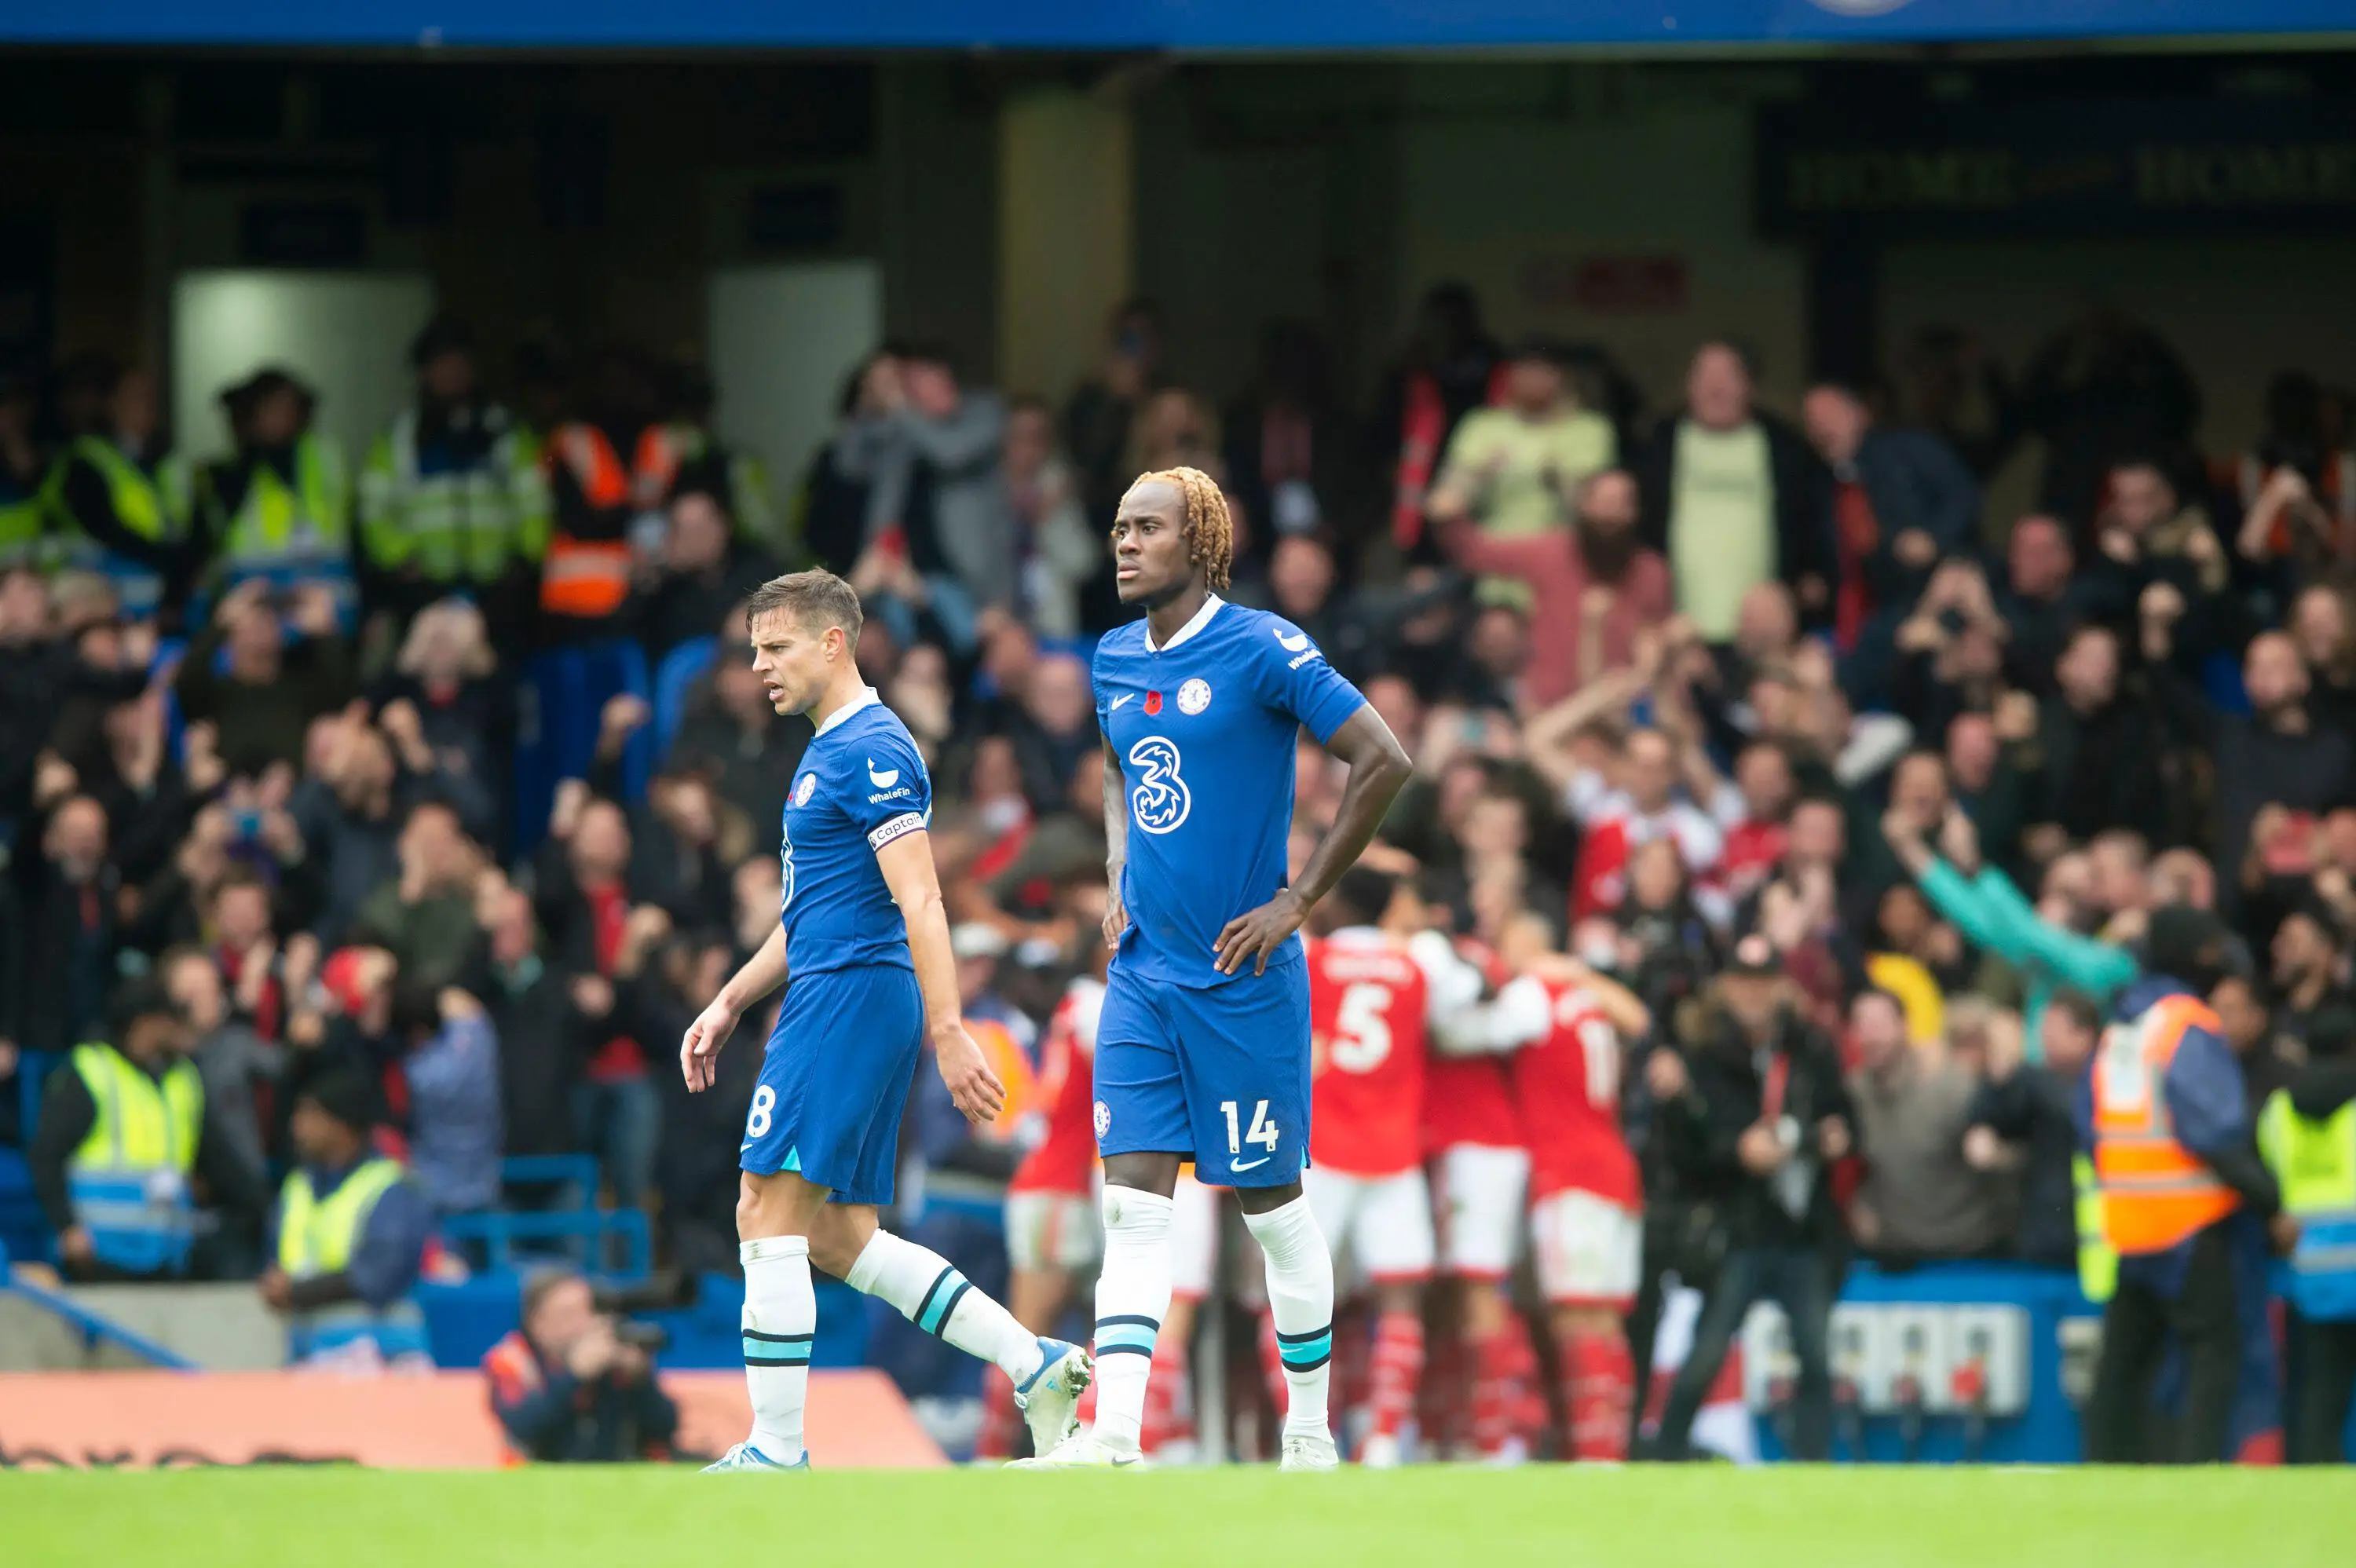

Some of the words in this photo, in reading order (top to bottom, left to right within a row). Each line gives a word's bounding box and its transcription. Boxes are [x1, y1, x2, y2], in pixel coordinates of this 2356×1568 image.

[869, 788, 910, 804] WhaleFin
[1331, 982, 1392, 1074] 5
[748, 1084, 776, 1138] 8
[1220, 1099, 1279, 1153] 14
